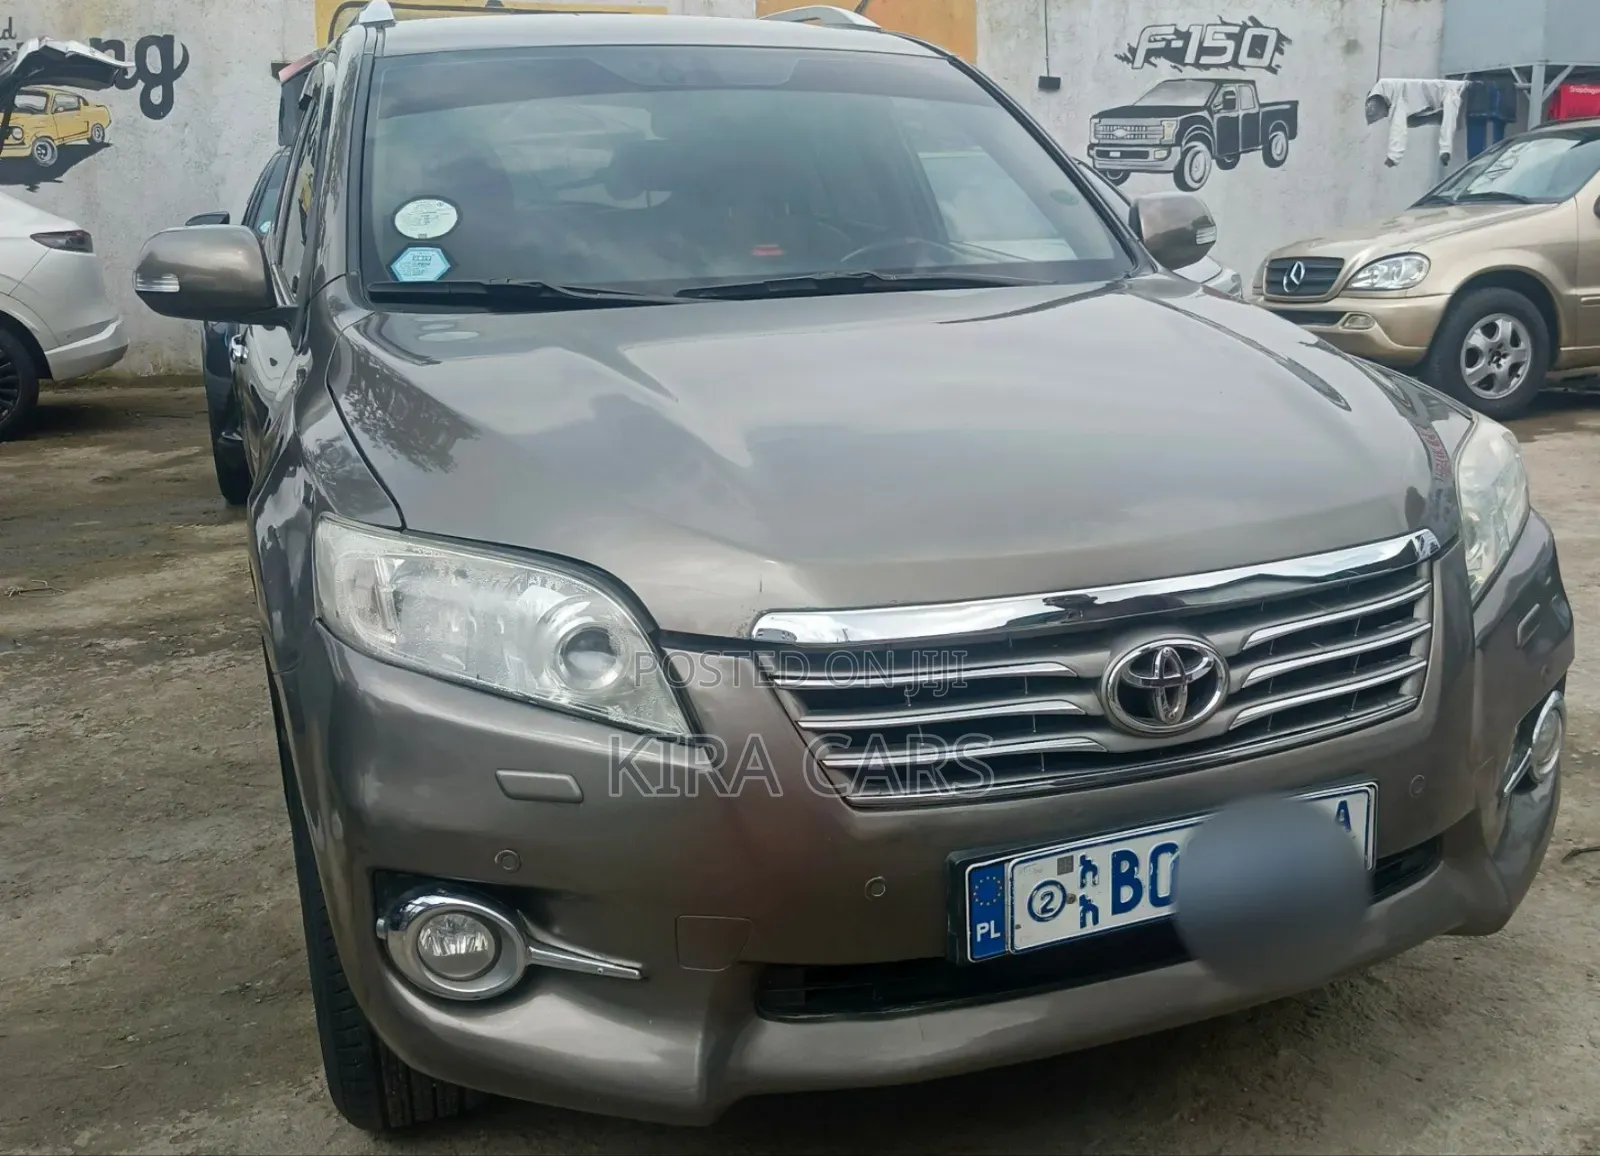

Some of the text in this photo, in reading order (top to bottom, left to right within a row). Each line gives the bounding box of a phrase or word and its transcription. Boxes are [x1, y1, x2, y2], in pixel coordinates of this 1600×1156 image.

[1131, 23, 1280, 70] F-150
[1040, 890, 1055, 915] 2
[976, 920, 1001, 942] PL
